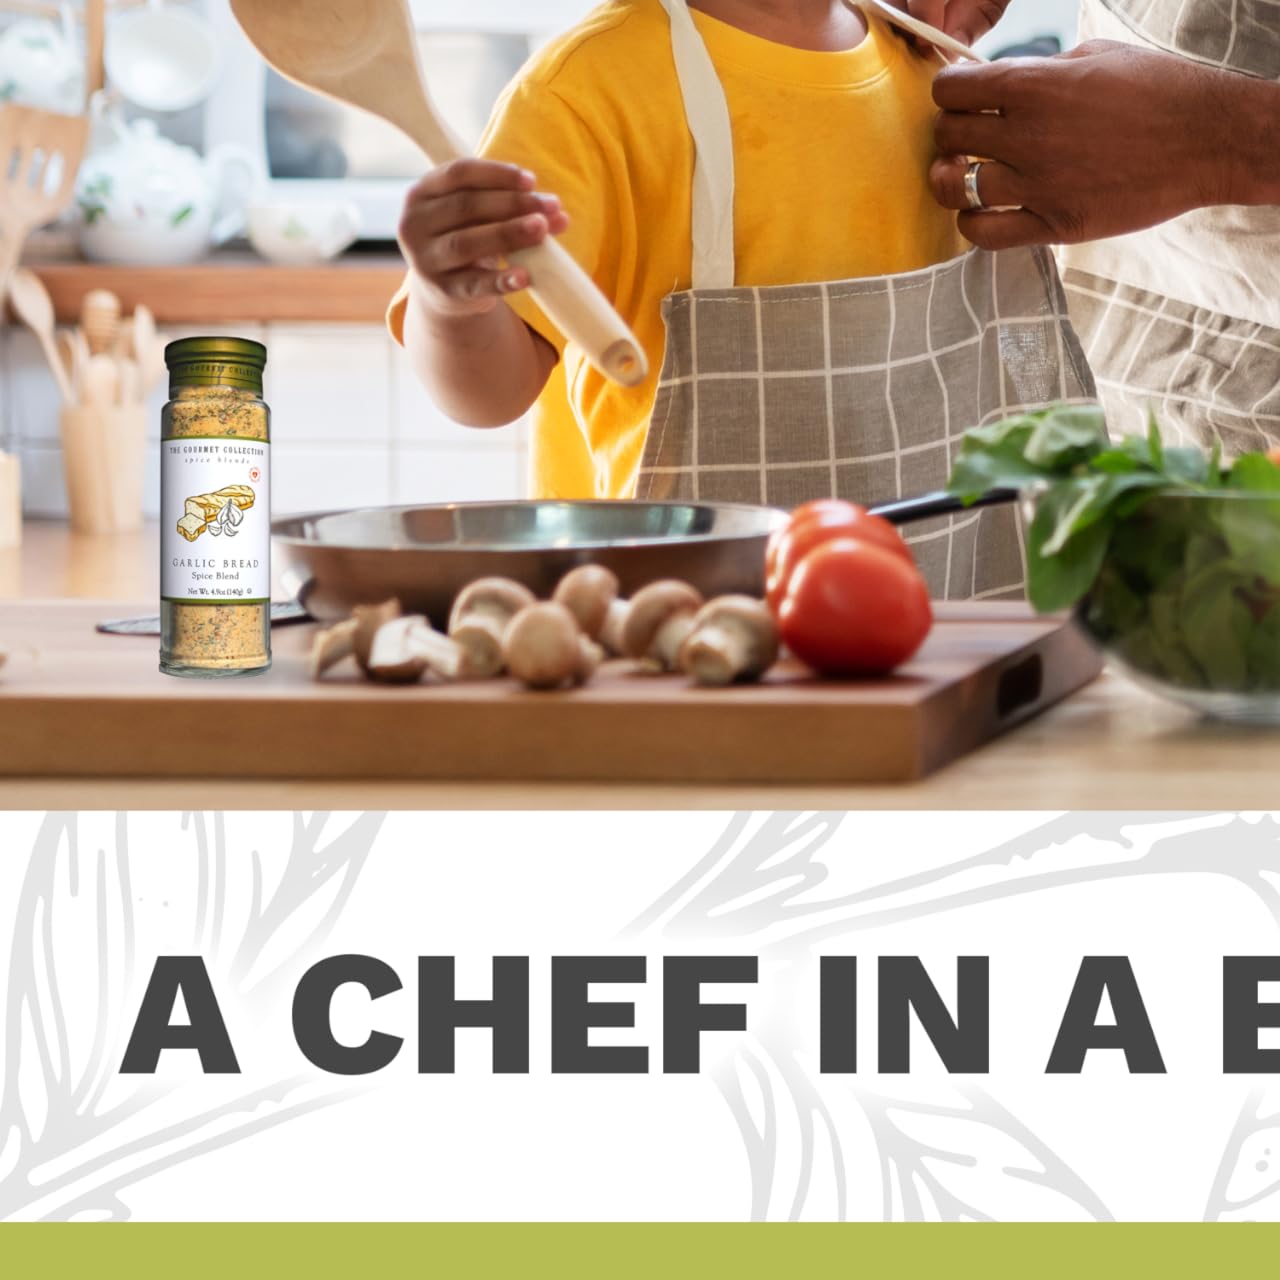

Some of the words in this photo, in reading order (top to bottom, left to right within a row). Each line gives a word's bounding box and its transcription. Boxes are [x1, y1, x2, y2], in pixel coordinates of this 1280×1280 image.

[172, 558, 216, 568] GARLIC
[223, 559, 259, 568] BREAD
[191, 571, 213, 581] Spice
[216, 571, 240, 580] Blend
